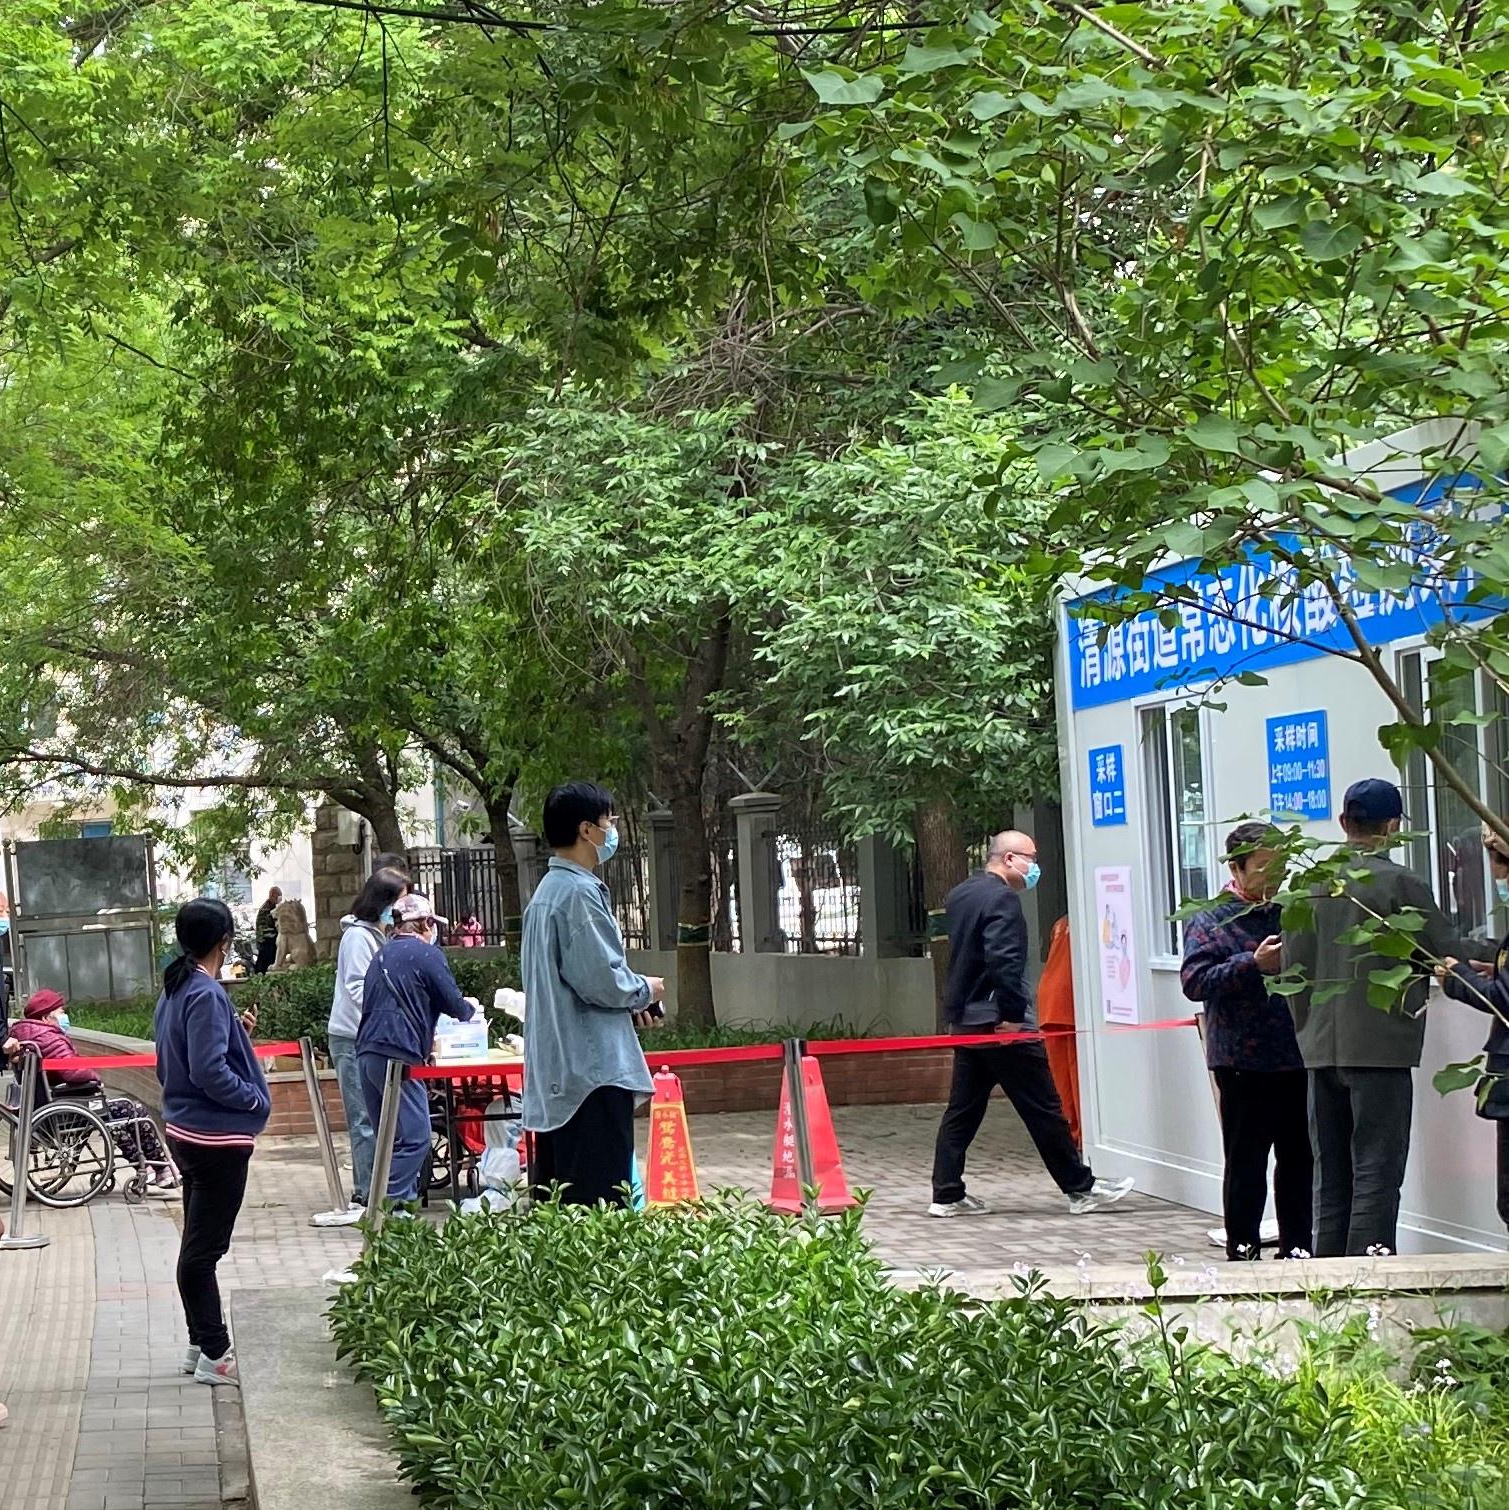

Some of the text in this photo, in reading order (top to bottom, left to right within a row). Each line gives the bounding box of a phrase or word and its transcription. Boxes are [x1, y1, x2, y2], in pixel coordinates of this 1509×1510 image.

[1273, 721, 1319, 753] 采样时间
[1095, 752, 1117, 784] 采样
[1092, 790, 1124, 820] 窗口二
